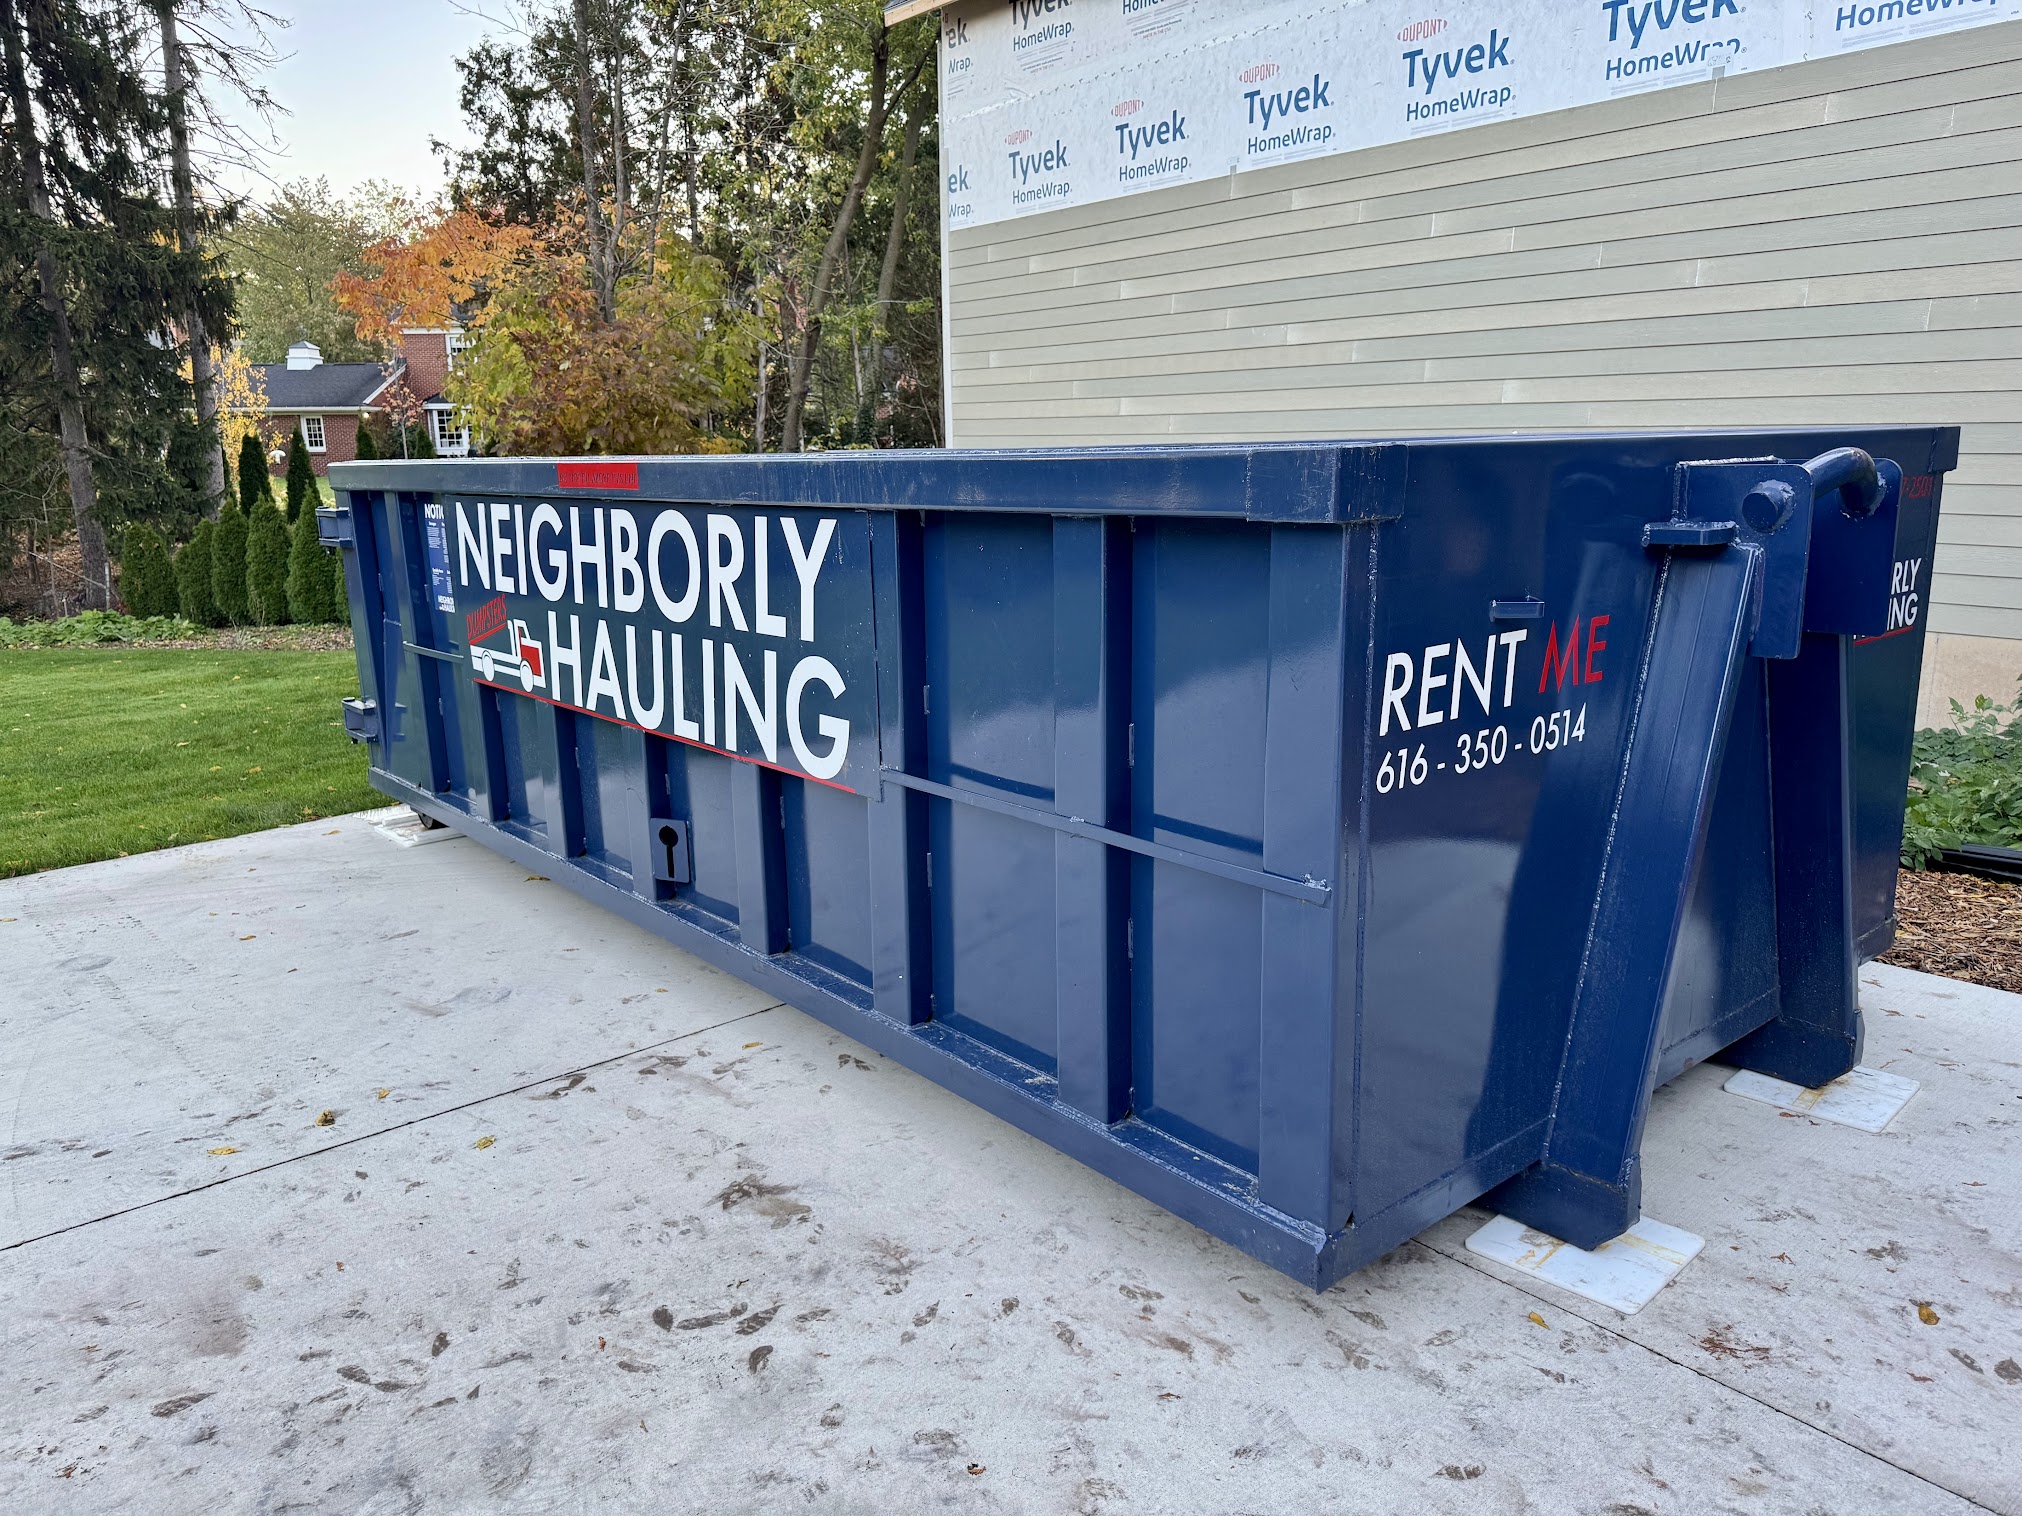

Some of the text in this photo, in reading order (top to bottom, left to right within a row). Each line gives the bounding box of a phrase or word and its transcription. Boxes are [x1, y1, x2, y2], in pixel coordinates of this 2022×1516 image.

[1008, 0, 1069, 30] Tyve
[1402, 18, 1443, 42] DUPONT
[1013, 21, 1072, 52] HomeWrap
[1243, 63, 1276, 83] DUPONT
[1402, 28, 1510, 95] Tyvek
[1114, 99, 1141, 117] DUPONT
[1243, 73, 1330, 131] Tyvek
[1406, 86, 1511, 122] HomeWrap
[1115, 109, 1186, 160] Tyvek
[1247, 125, 1332, 155] HomeWrap
[1008, 139, 1068, 185] Tyvek
[1119, 156, 1188, 182] HomeWrap
[1013, 182, 1070, 205] HomeWrap
[455, 501, 837, 642] NEIGHBORLY
[1891, 557, 1922, 595] RLY
[466, 593, 507, 640] DUMPSTERS
[1379, 613, 1611, 737] RENT ME
[547, 610, 850, 780] HAULING
[1375, 743, 1428, 794] 616
[1454, 725, 1508, 774] 350
[1530, 702, 1587, 755] 0514
